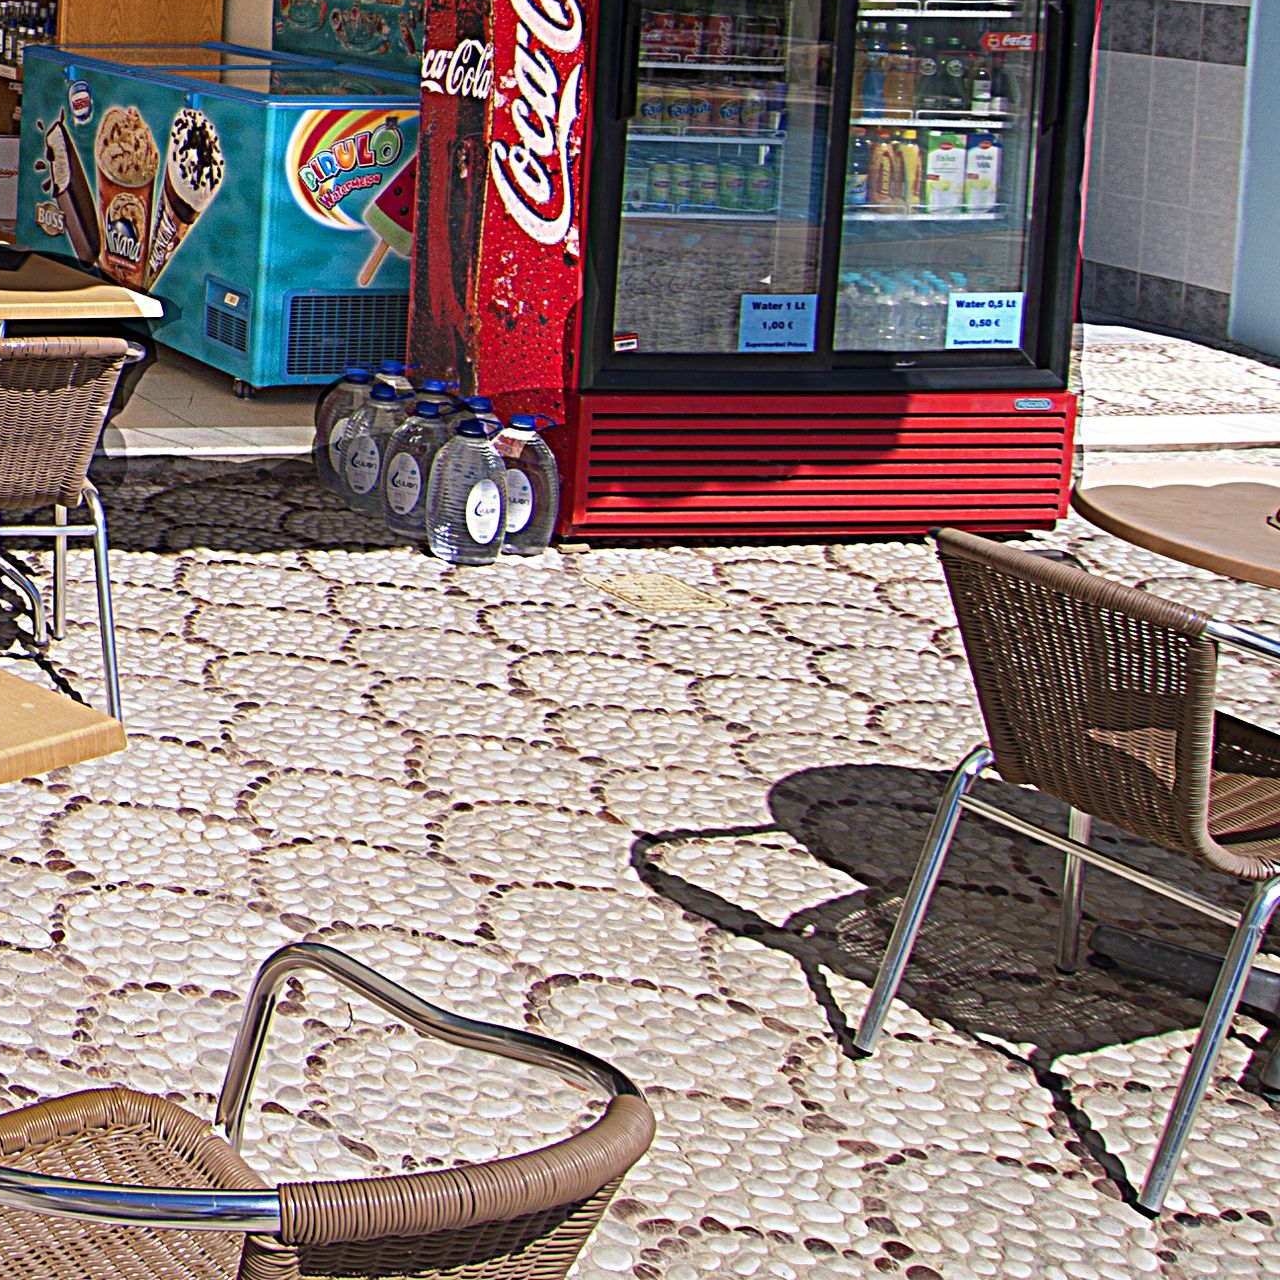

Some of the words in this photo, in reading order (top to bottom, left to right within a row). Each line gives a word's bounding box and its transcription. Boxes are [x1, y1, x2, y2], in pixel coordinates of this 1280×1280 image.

[38, 206, 65, 230] BOSS
[752, 301, 783, 311] Water
[785, 301, 791, 310] 1
[956, 300, 985, 309] Water
[1006, 300, 1016, 308] Lt
[762, 321, 784, 331] 1,00
[969, 319, 992, 328] 0,50
[994, 319, 1001, 327] €
